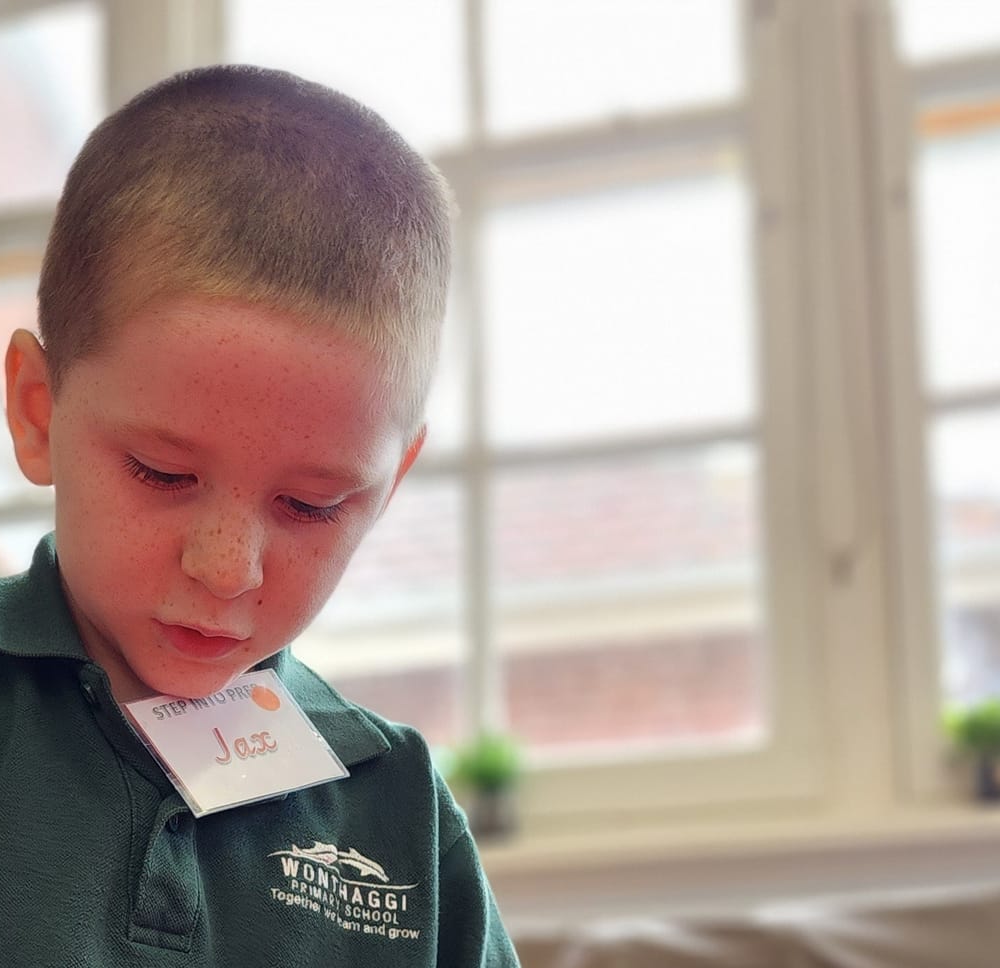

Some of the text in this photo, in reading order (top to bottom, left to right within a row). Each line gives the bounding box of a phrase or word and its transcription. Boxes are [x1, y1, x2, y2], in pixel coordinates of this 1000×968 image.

[152, 702, 187, 720] STEP
[213, 727, 277, 764] Jax
[281, 857, 407, 911] WONTHAGGI
[291, 879, 400, 926] PRIMARY SCHOOL
[363, 923, 386, 937] and
[388, 926, 421, 940] grow
